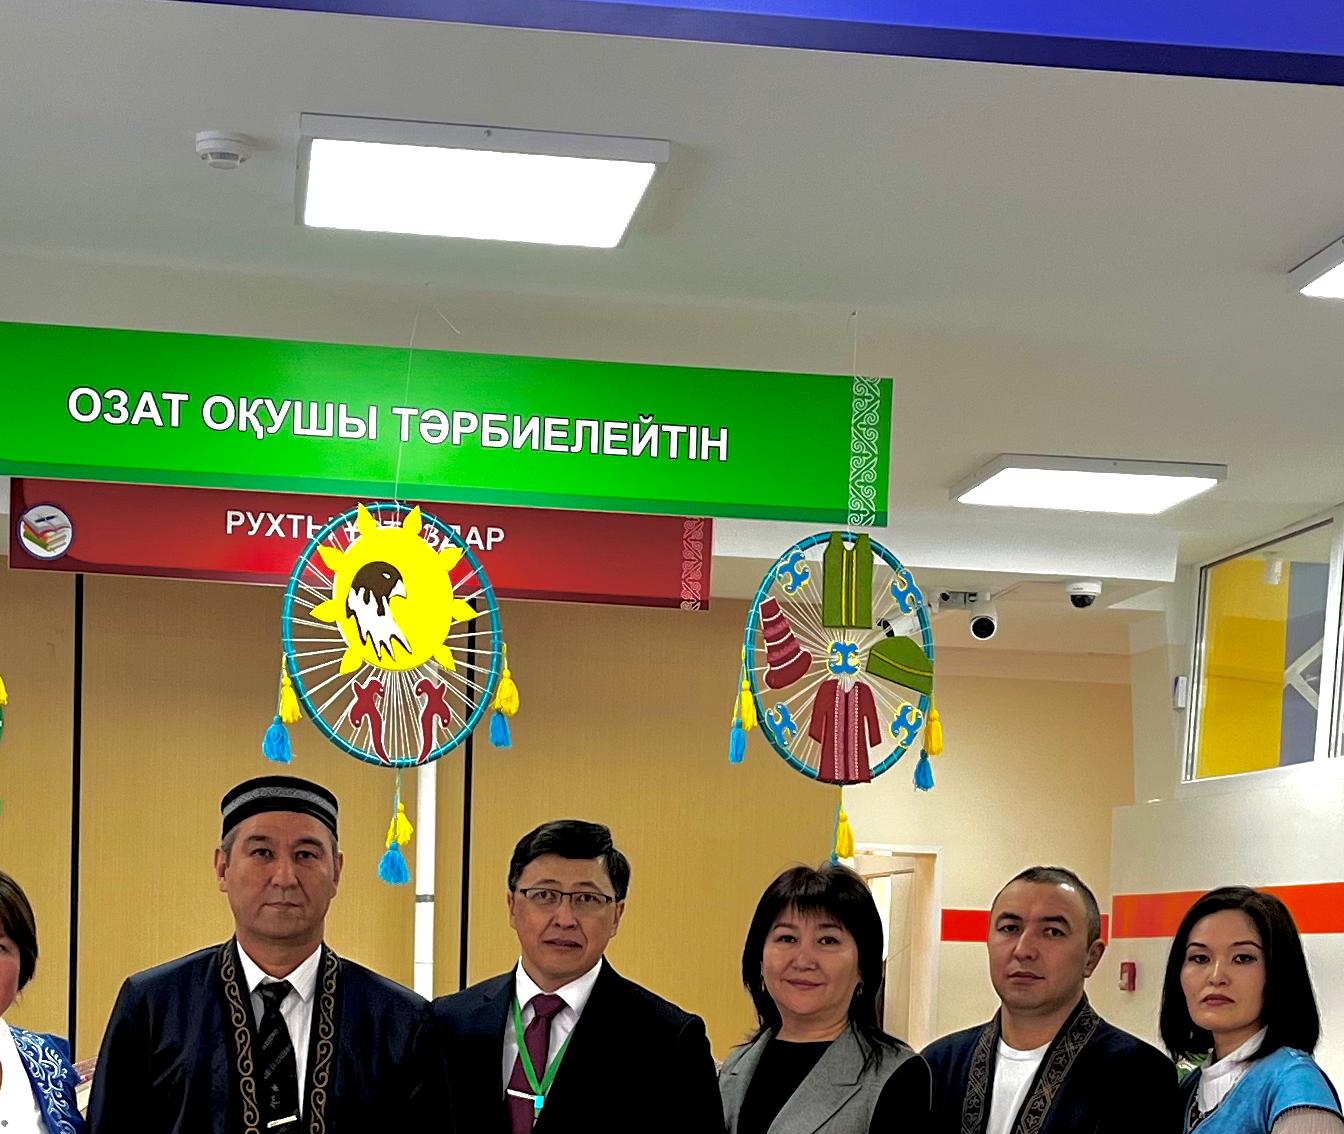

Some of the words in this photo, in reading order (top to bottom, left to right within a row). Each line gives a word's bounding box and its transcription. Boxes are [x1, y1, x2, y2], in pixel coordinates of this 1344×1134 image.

[65, 385, 190, 430] ОЗАТ
[201, 393, 380, 443] ОҚУШЫ
[392, 405, 730, 463] ТӘРБИЕЛЕЙТІН
